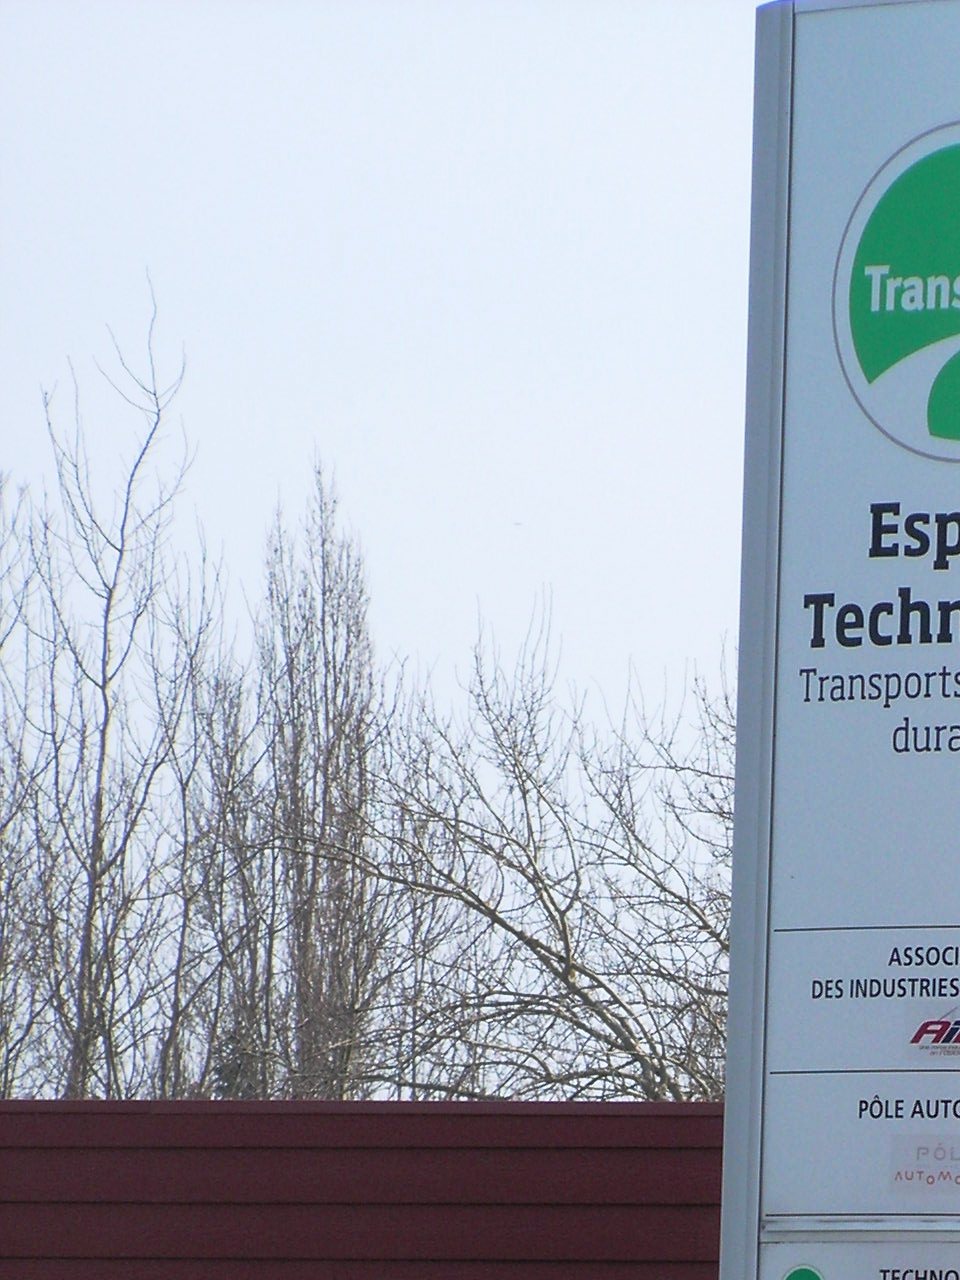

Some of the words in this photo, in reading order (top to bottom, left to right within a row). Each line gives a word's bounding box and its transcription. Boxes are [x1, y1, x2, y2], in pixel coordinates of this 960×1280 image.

[811, 979, 844, 999] DES
[849, 977, 960, 998] INDUSTRIES
[858, 1095, 905, 1119] PÔLE
